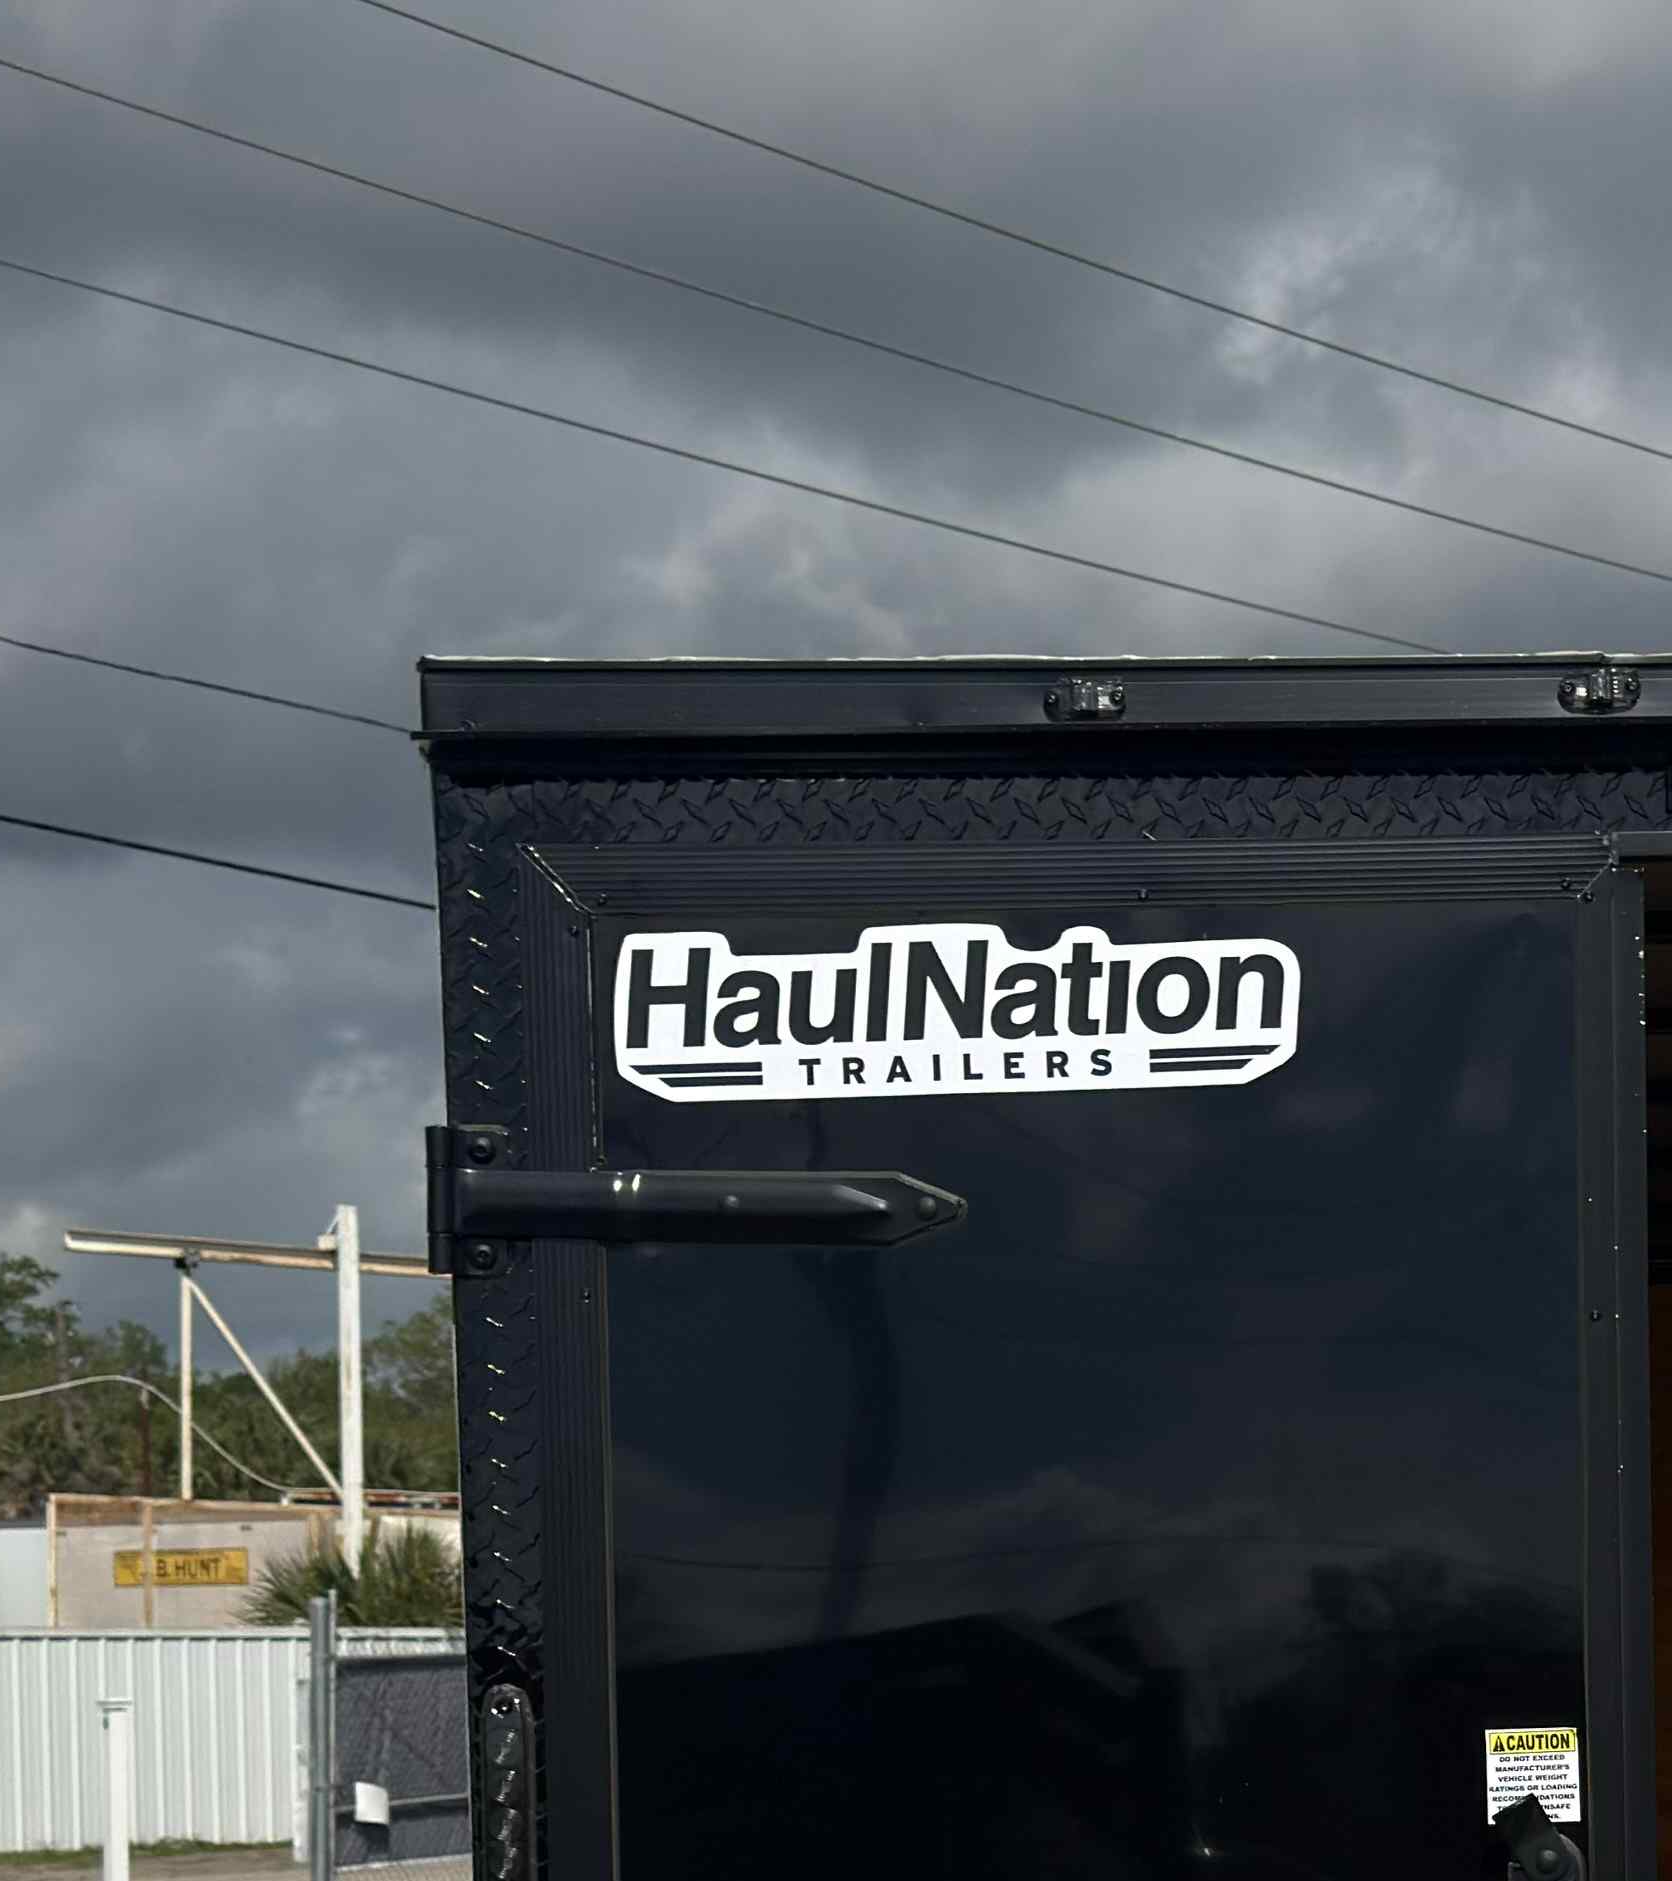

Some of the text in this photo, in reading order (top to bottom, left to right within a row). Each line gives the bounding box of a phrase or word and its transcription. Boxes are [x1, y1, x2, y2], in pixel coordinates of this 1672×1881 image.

[625, 938, 1285, 1049] HaulNation
[798, 1047, 1114, 1087] TRAILERS
[174, 1557, 221, 1579] HUNT
[1506, 1733, 1570, 1751] CAUTION
[1495, 1763, 1570, 1772] MANUFACTURER'S
[1497, 1773, 1568, 1782] VEHICLE WEIGHT
[1489, 1785, 1525, 1793] RATINGS
[1541, 1783, 1578, 1791] LOADING
